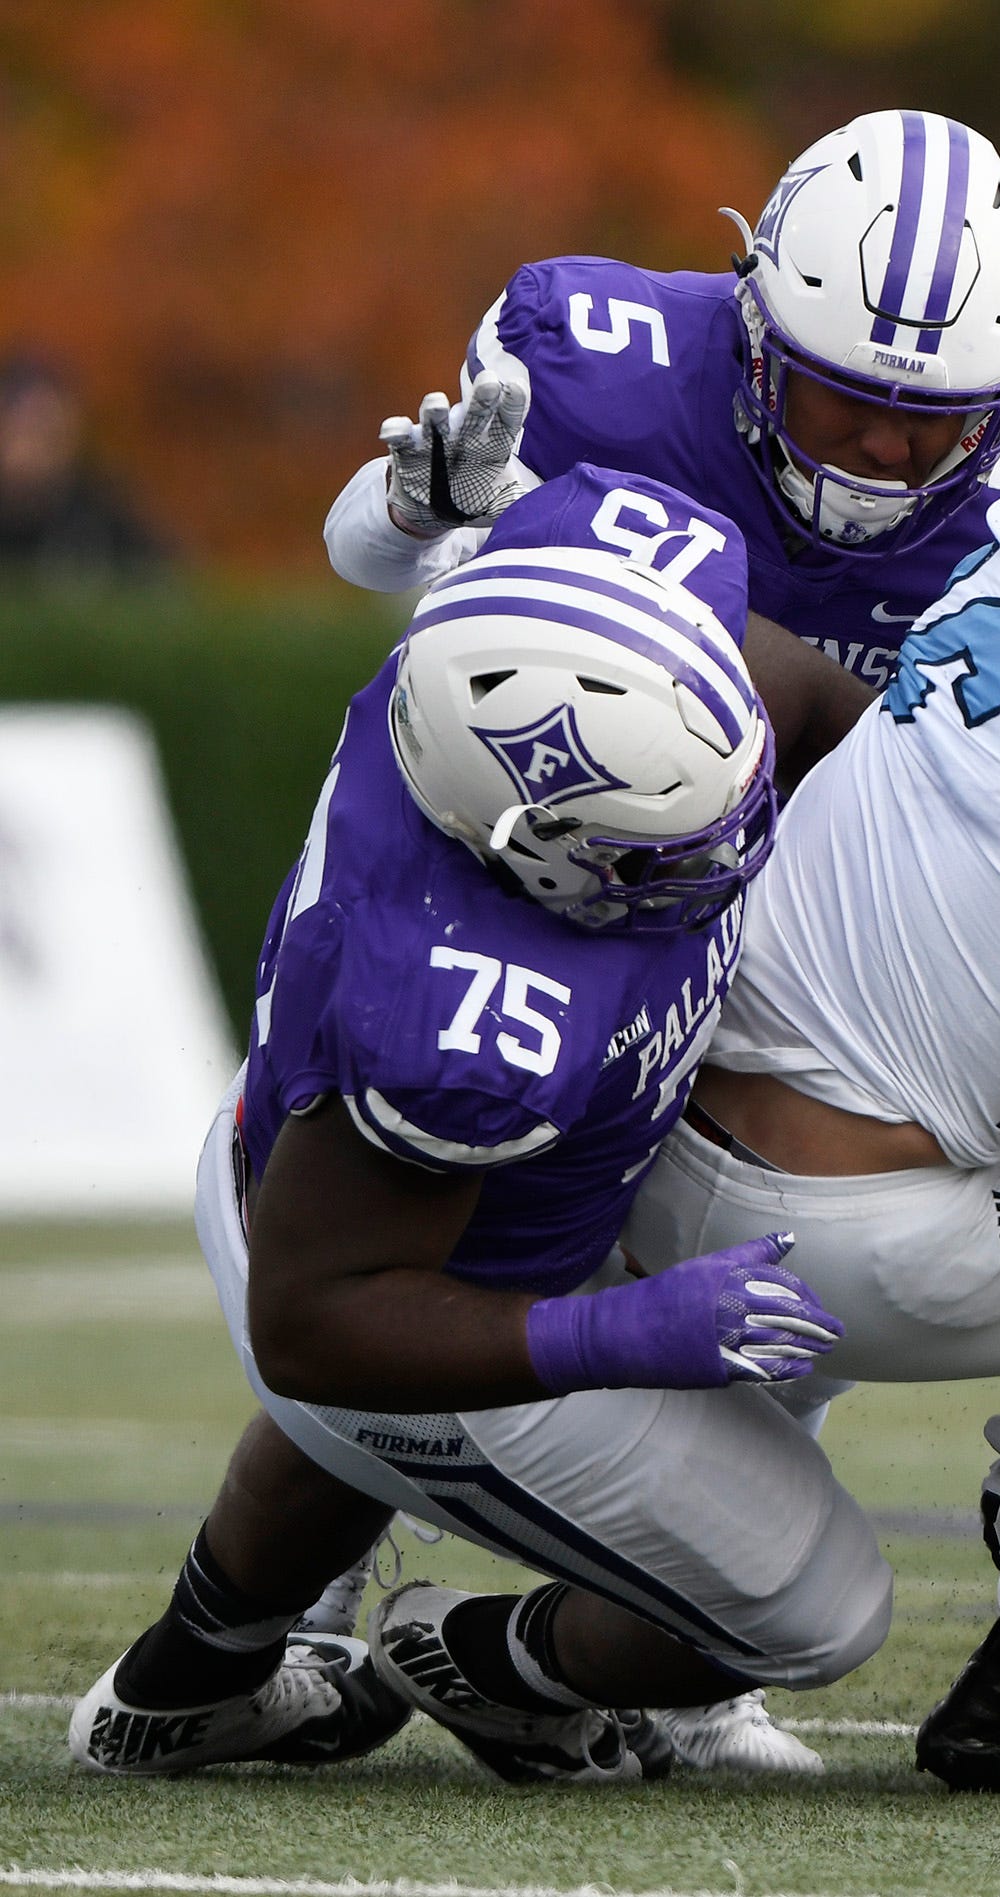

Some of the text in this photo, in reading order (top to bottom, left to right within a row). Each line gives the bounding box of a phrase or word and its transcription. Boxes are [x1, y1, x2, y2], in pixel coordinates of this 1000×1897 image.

[568, 291, 671, 367] 5
[872, 350, 926, 374] FURMAN
[523, 741, 570, 784] F
[429, 945, 572, 1078] 75
[355, 1428, 465, 1458] FURMAN
